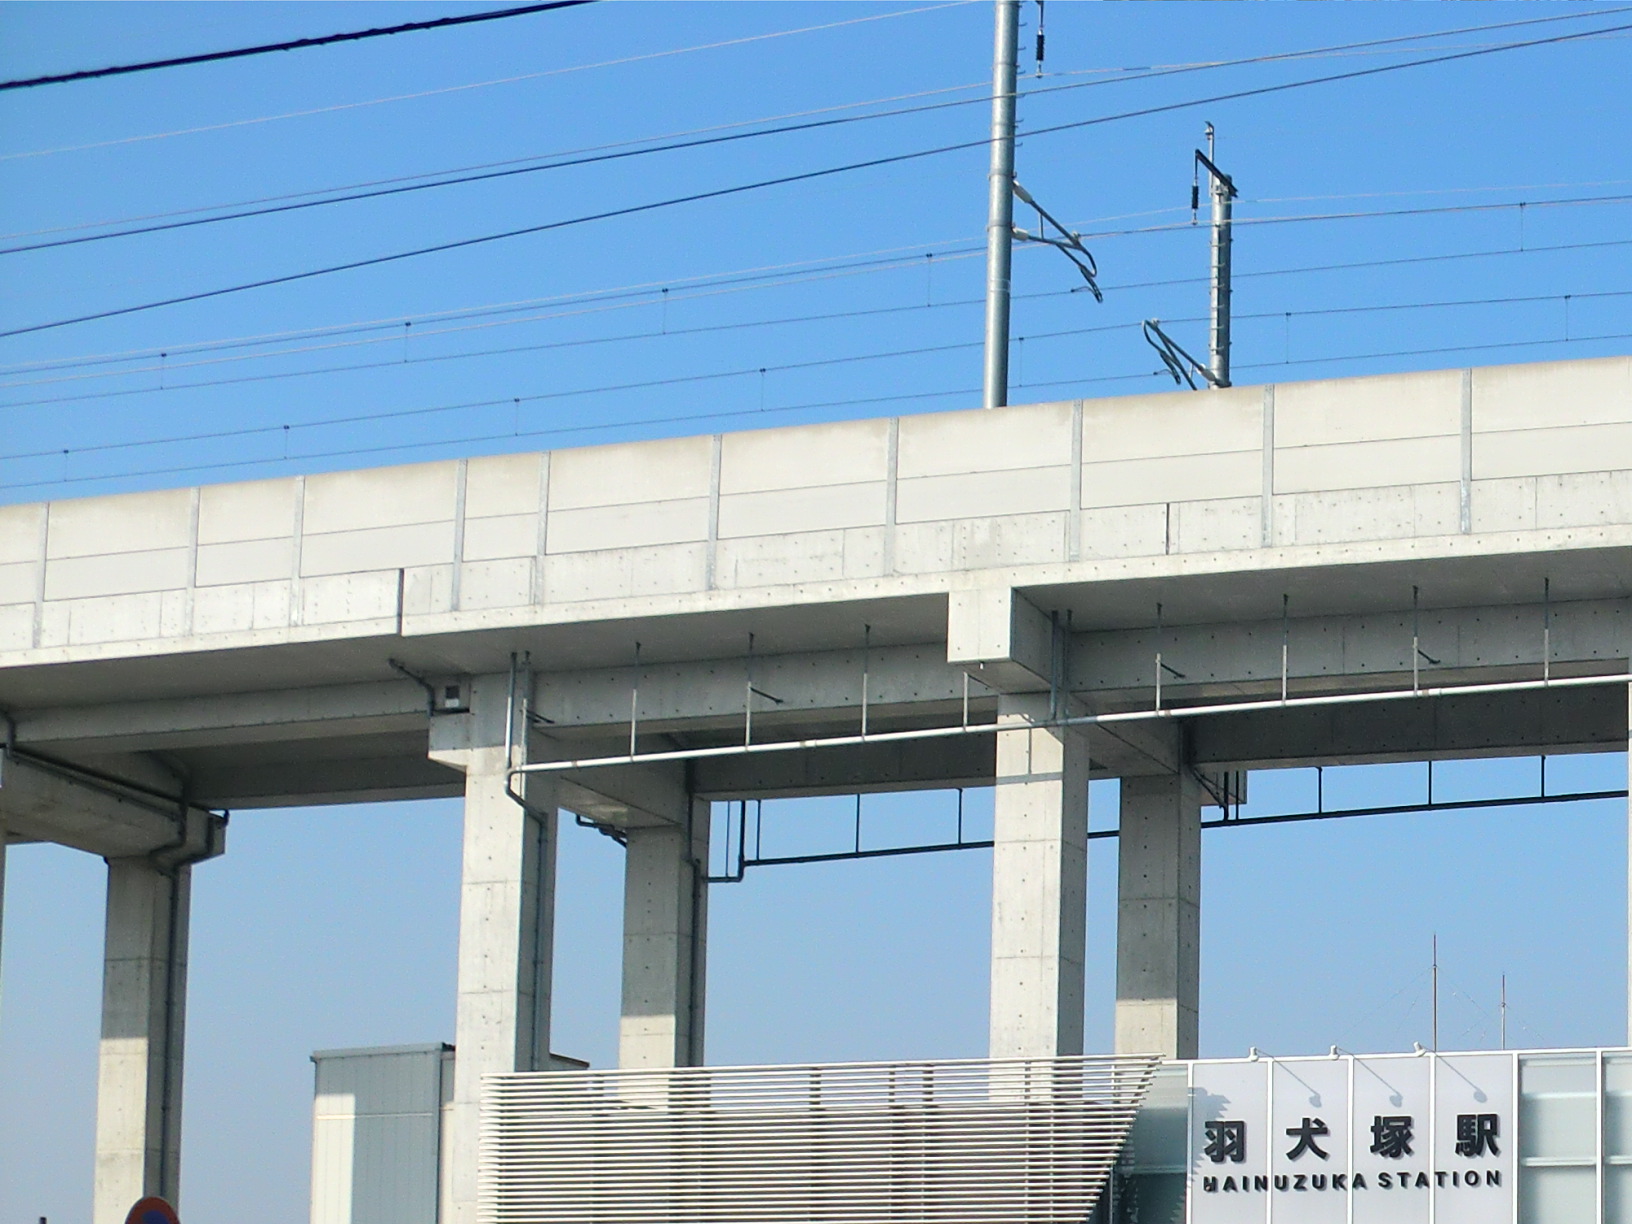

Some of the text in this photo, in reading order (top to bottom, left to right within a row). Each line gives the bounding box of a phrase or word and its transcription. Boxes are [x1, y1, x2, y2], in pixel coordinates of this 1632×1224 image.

[1203, 1113, 1500, 1163] 羽犬塚駅
[1203, 1168, 1502, 1192] HAINUZUKA STATION
